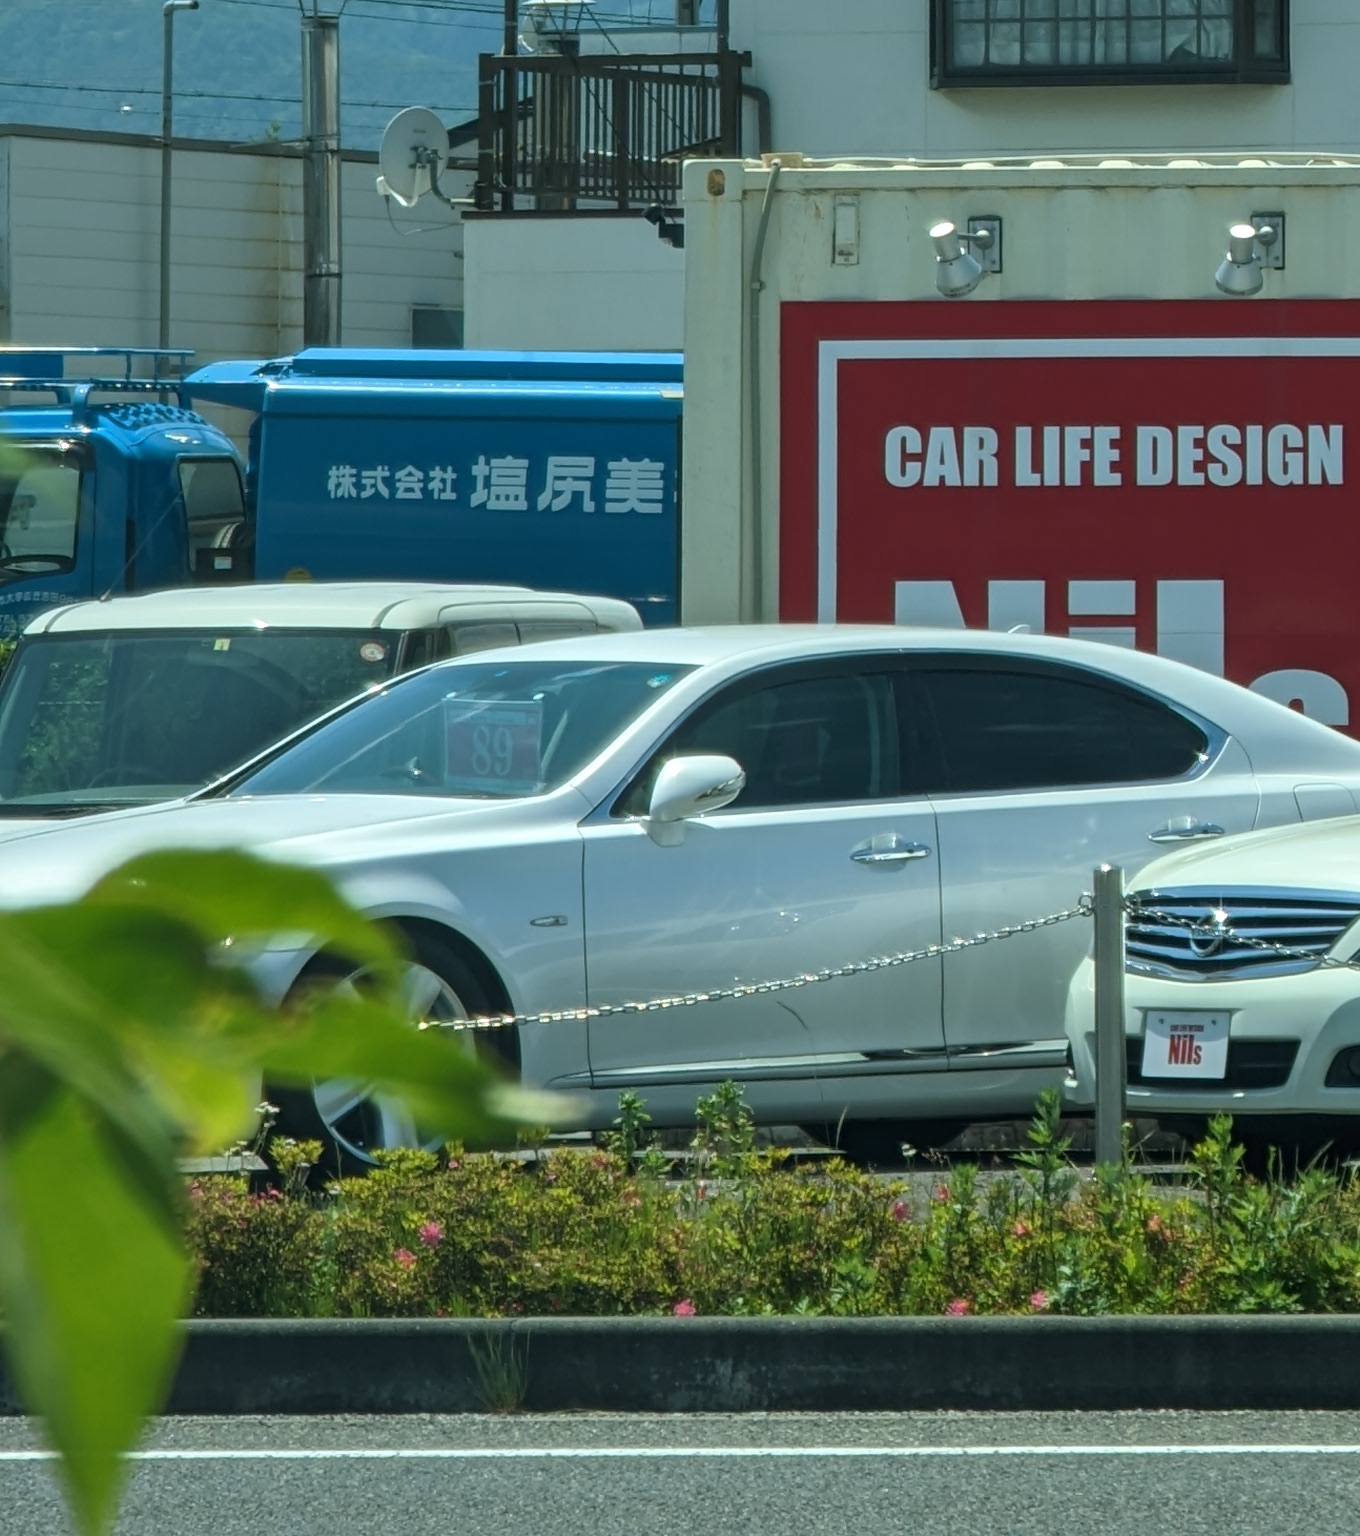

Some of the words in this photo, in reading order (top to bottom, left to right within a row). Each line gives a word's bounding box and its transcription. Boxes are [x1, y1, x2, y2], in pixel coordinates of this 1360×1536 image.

[885, 425, 999, 487] CAR
[1015, 425, 1122, 487] LIFE
[1136, 423, 1344, 487] DESIGN
[327, 464, 457, 500] 株式会社
[470, 455, 677, 514] 塩尻美
[472, 725, 513, 776] 89
[1168, 1034, 1202, 1065] Nils
